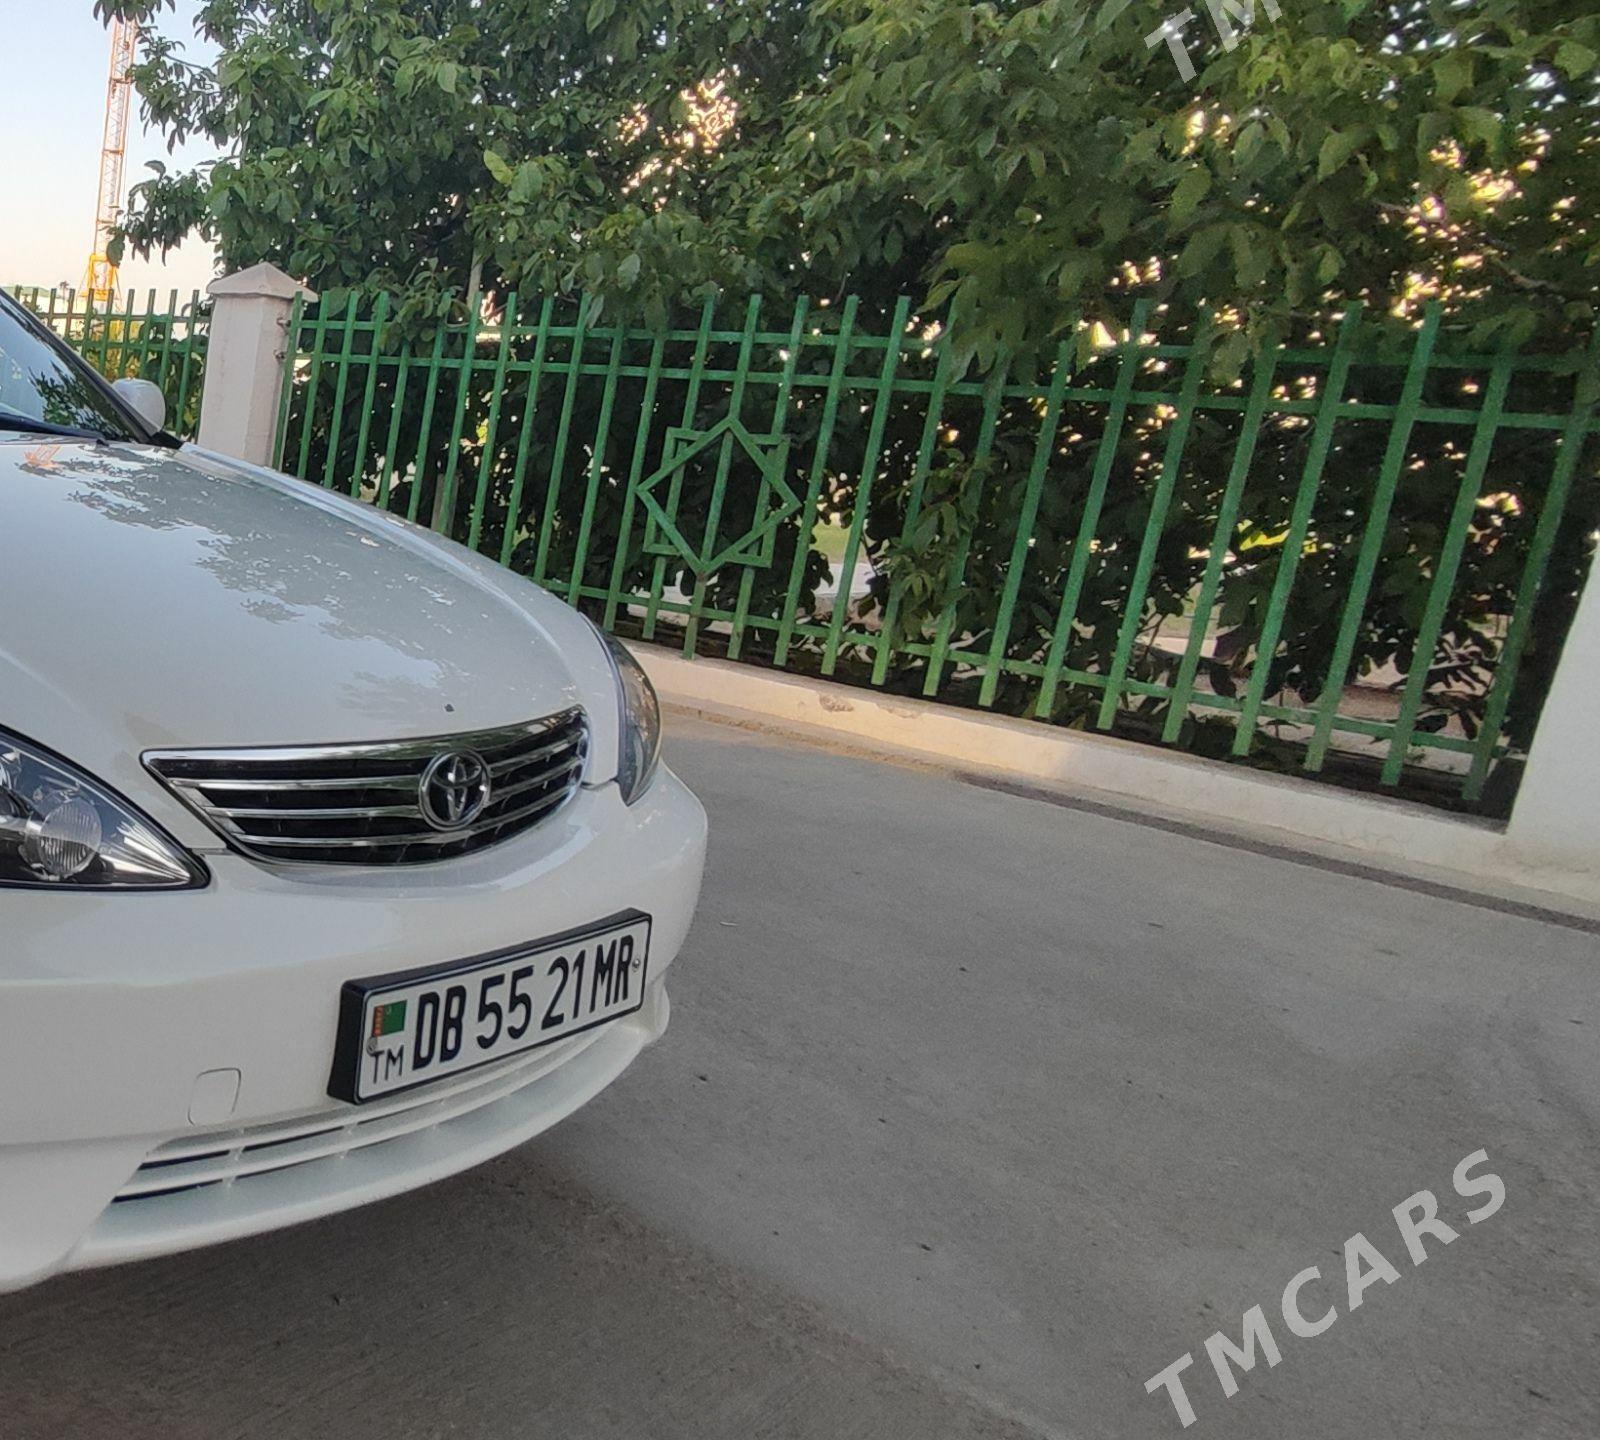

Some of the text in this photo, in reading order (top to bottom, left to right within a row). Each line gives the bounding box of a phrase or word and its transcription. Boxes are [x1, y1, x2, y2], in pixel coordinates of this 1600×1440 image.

[412, 934, 635, 1070] DB 55 21 MR
[369, 1045, 405, 1084] TM
